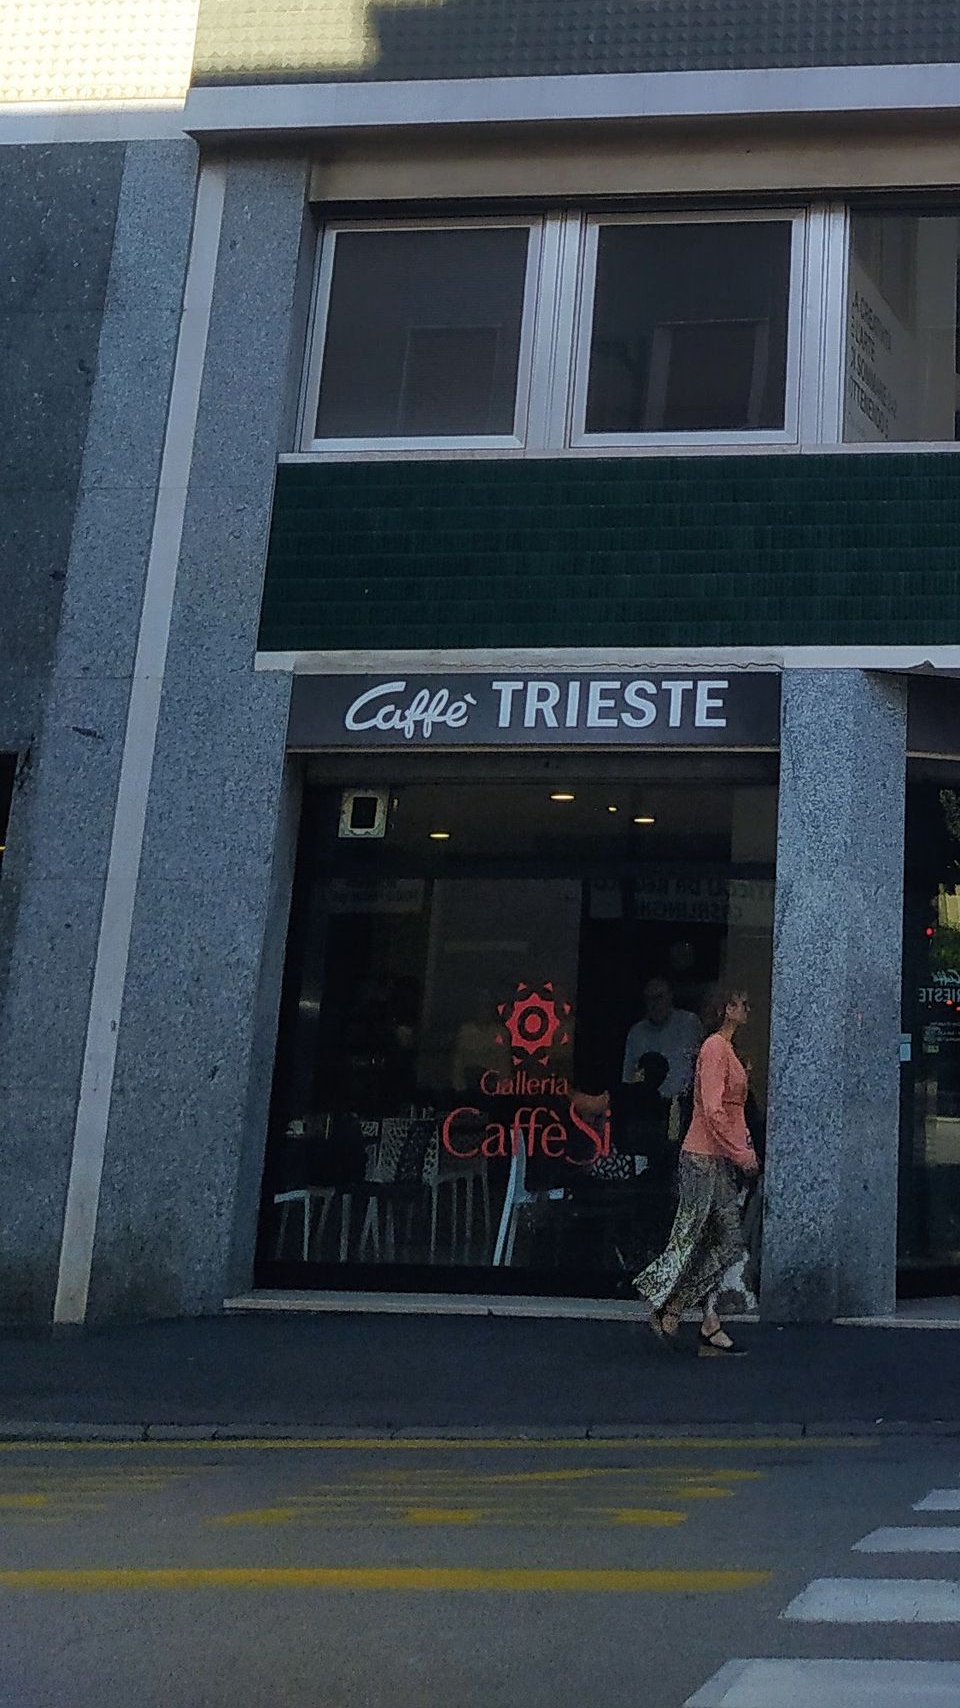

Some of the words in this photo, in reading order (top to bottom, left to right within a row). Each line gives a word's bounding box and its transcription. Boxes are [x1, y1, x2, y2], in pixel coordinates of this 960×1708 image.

[344, 680, 478, 739] Caffè
[491, 679, 729, 729] TRIESTE
[479, 1069, 569, 1096] Galleria
